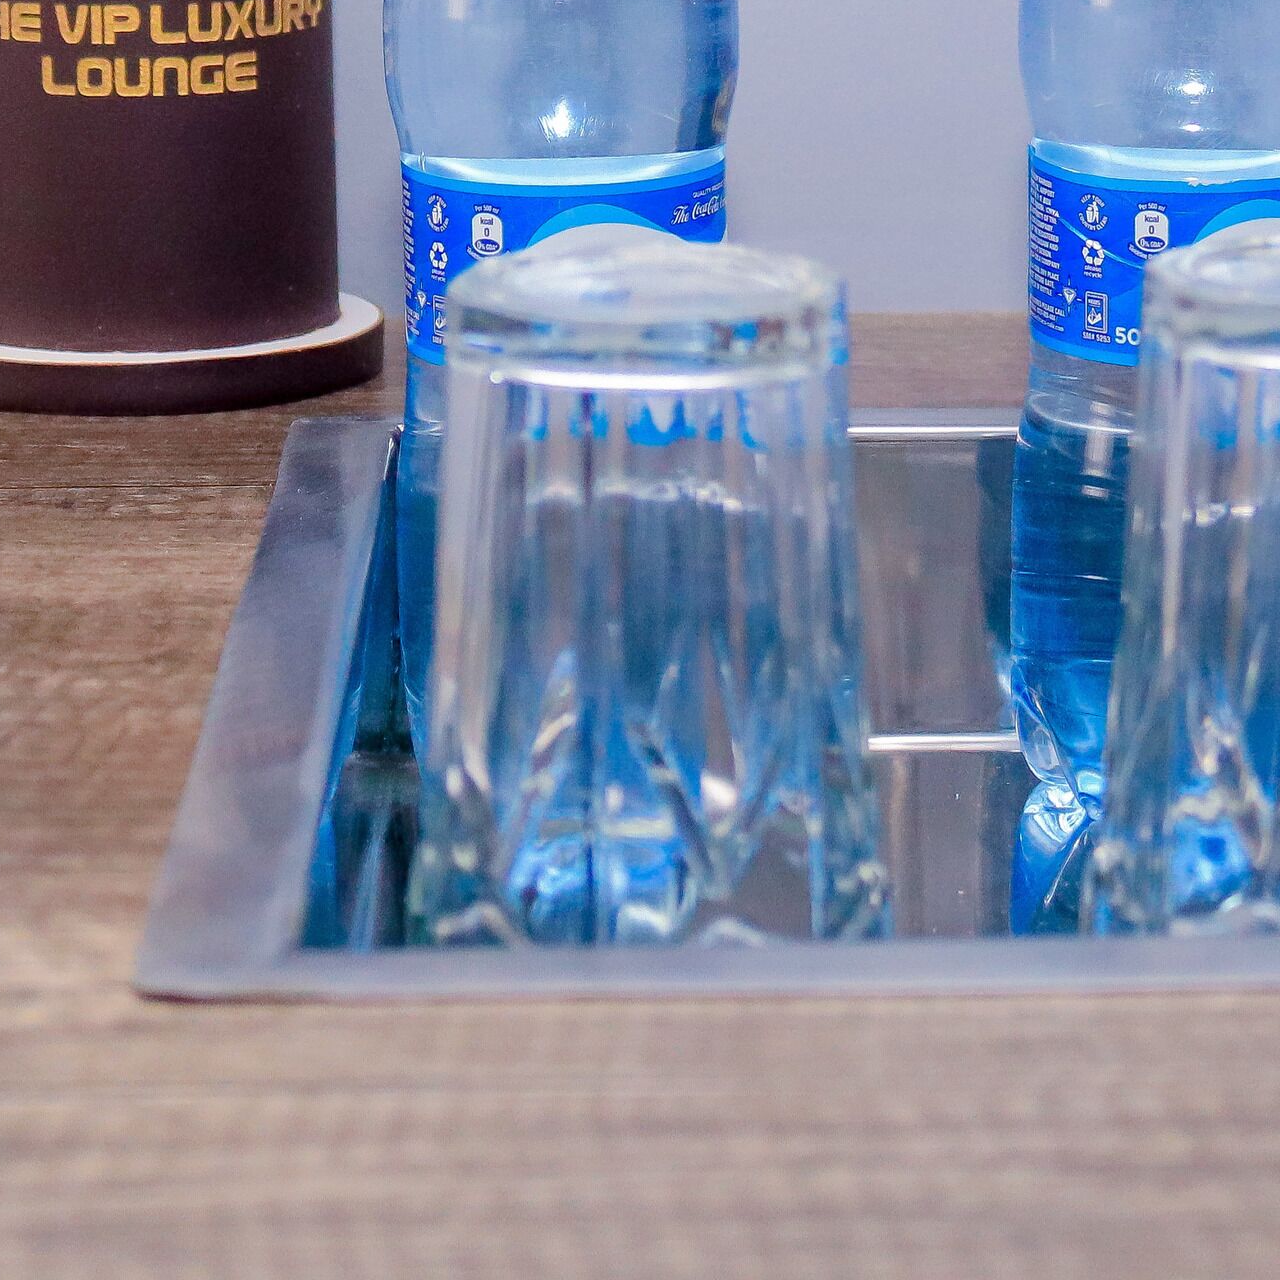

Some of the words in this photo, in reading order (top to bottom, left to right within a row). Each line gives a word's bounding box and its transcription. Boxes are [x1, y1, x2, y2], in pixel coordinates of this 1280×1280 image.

[54, 3, 139, 45] VIP
[41, 51, 259, 97] LOUNGE
[1147, 202, 1158, 210] 500
[671, 205, 689, 225] The
[1144, 215, 1160, 223] kcal
[480, 217, 494, 225] kcal
[484, 227, 490, 237] 0
[1148, 225, 1155, 235] 0
[1084, 264, 1102, 273] please
[1083, 271, 1103, 280] recycle
